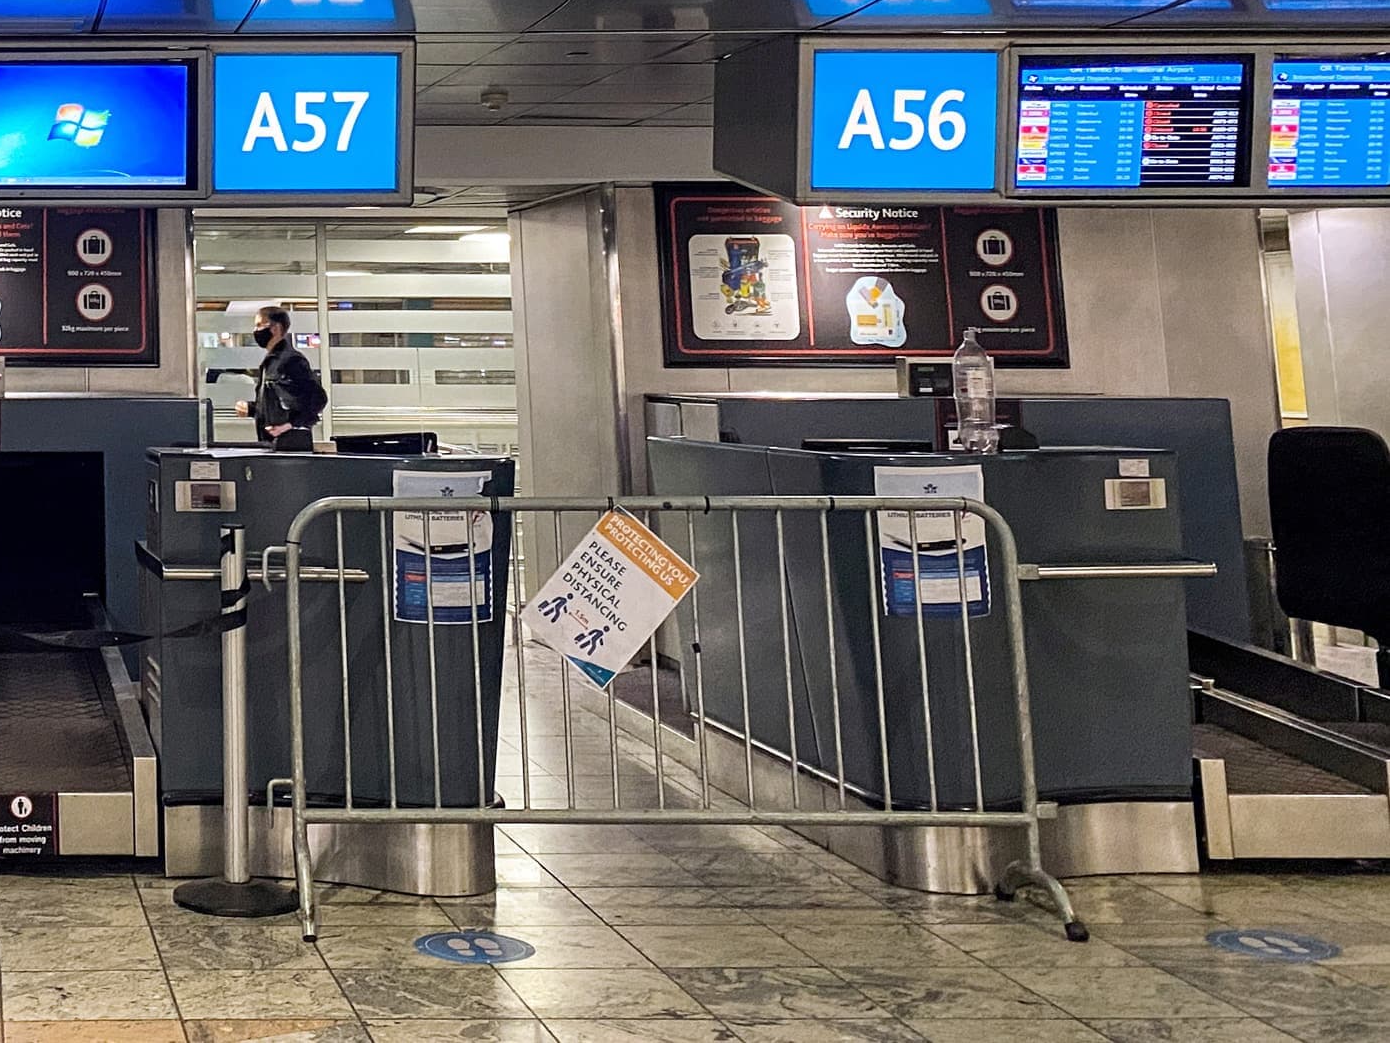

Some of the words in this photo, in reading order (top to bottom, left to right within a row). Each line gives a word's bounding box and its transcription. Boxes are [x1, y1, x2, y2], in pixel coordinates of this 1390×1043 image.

[242, 92, 369, 152] A57
[838, 89, 966, 150] A56
[835, 208, 880, 221] Security
[882, 208, 918, 217] Notice
[580, 551, 622, 590] ENSURE
[589, 541, 626, 576] PLEASE
[604, 524, 661, 575] PROTECTING
[659, 573, 675, 586] US
[611, 515, 668, 565] PROTECTING
[666, 562, 689, 587] YOU,
[563, 573, 627, 631] DISTANCING
[571, 562, 620, 609] PHYSICAL
[19, 836, 46, 844] moving
